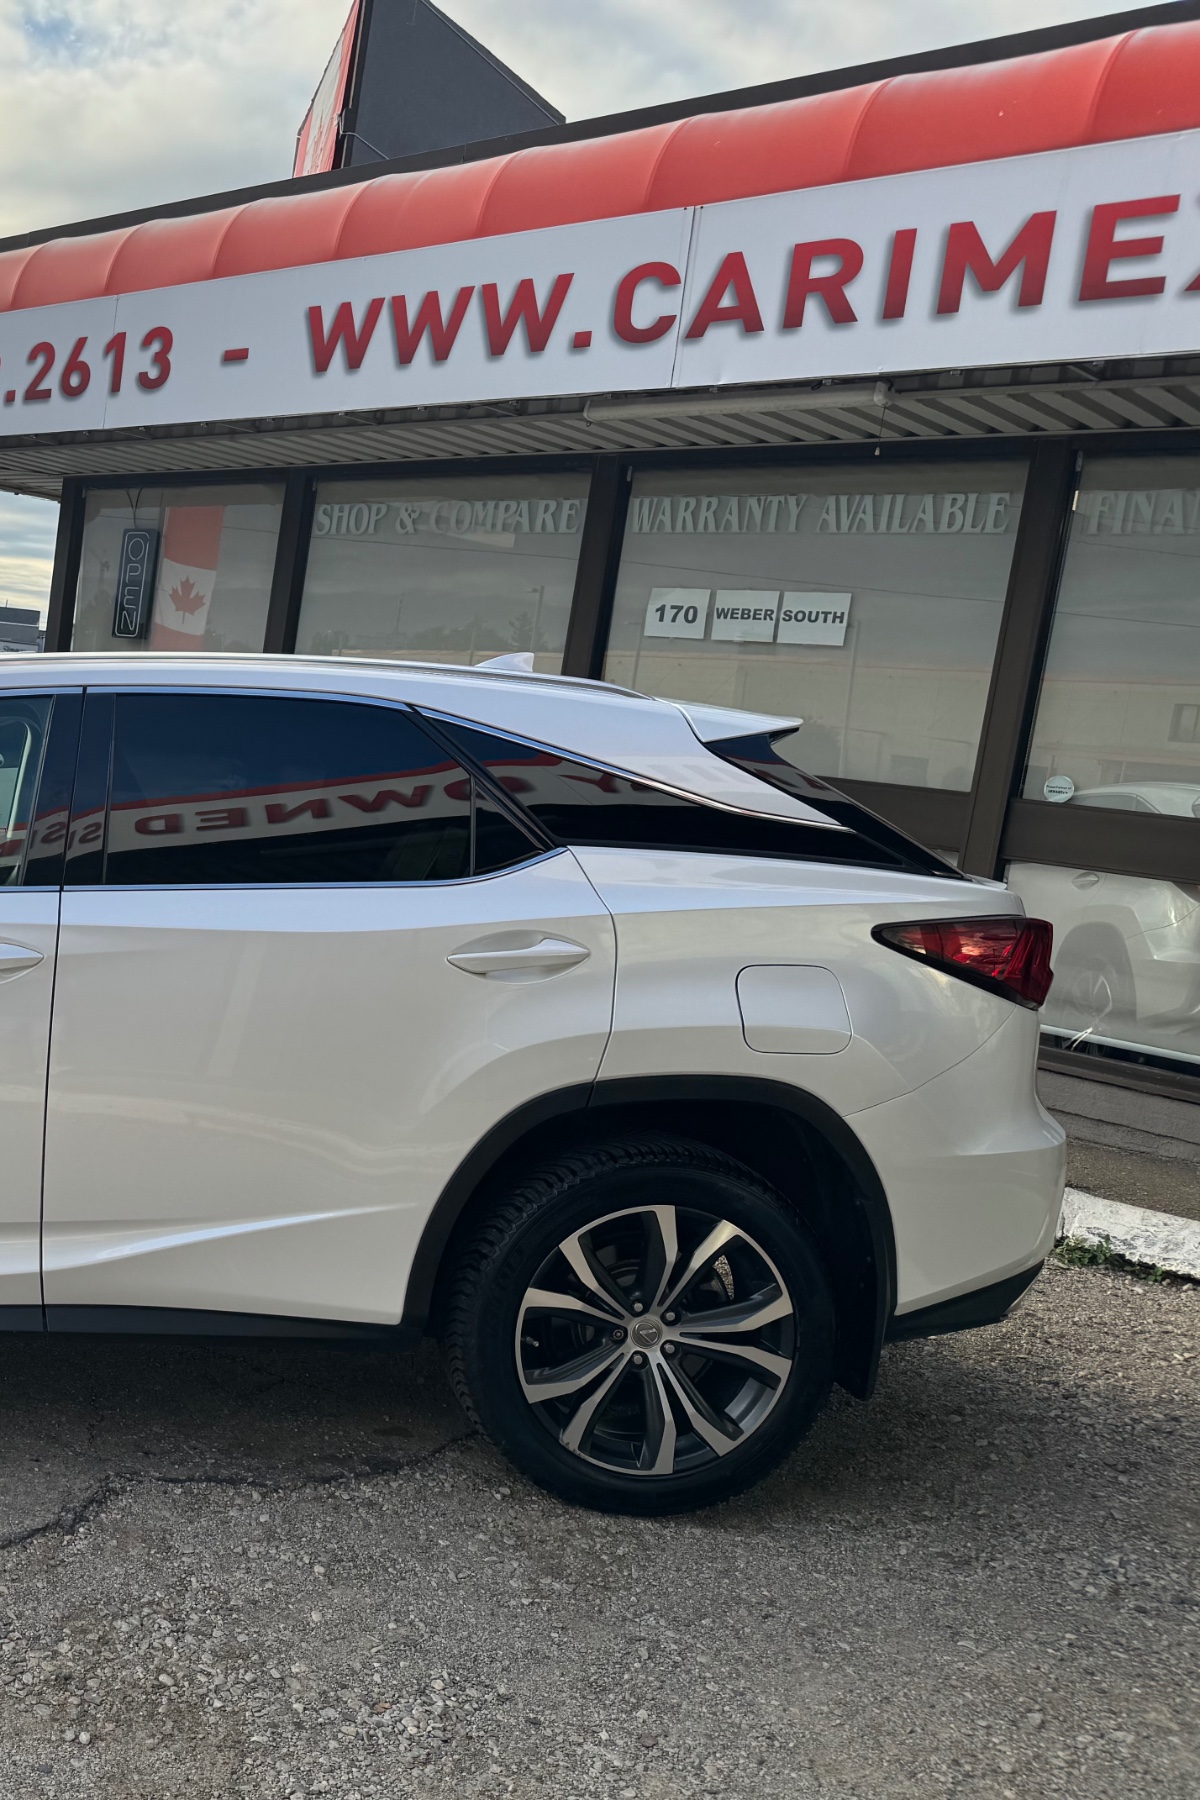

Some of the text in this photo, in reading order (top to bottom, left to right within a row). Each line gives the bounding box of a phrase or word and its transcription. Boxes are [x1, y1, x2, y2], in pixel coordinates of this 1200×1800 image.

[224, 347, 250, 361] -
[308, 193, 1200, 374] WWW.CARIME
[314, 498, 581, 536] SHOP & COMPARE
[632, 491, 1011, 534] WARRANTY AVAILABLE
[120, 537, 145, 631] OPEN
[655, 604, 845, 624] 170 WEBER SOUTH
